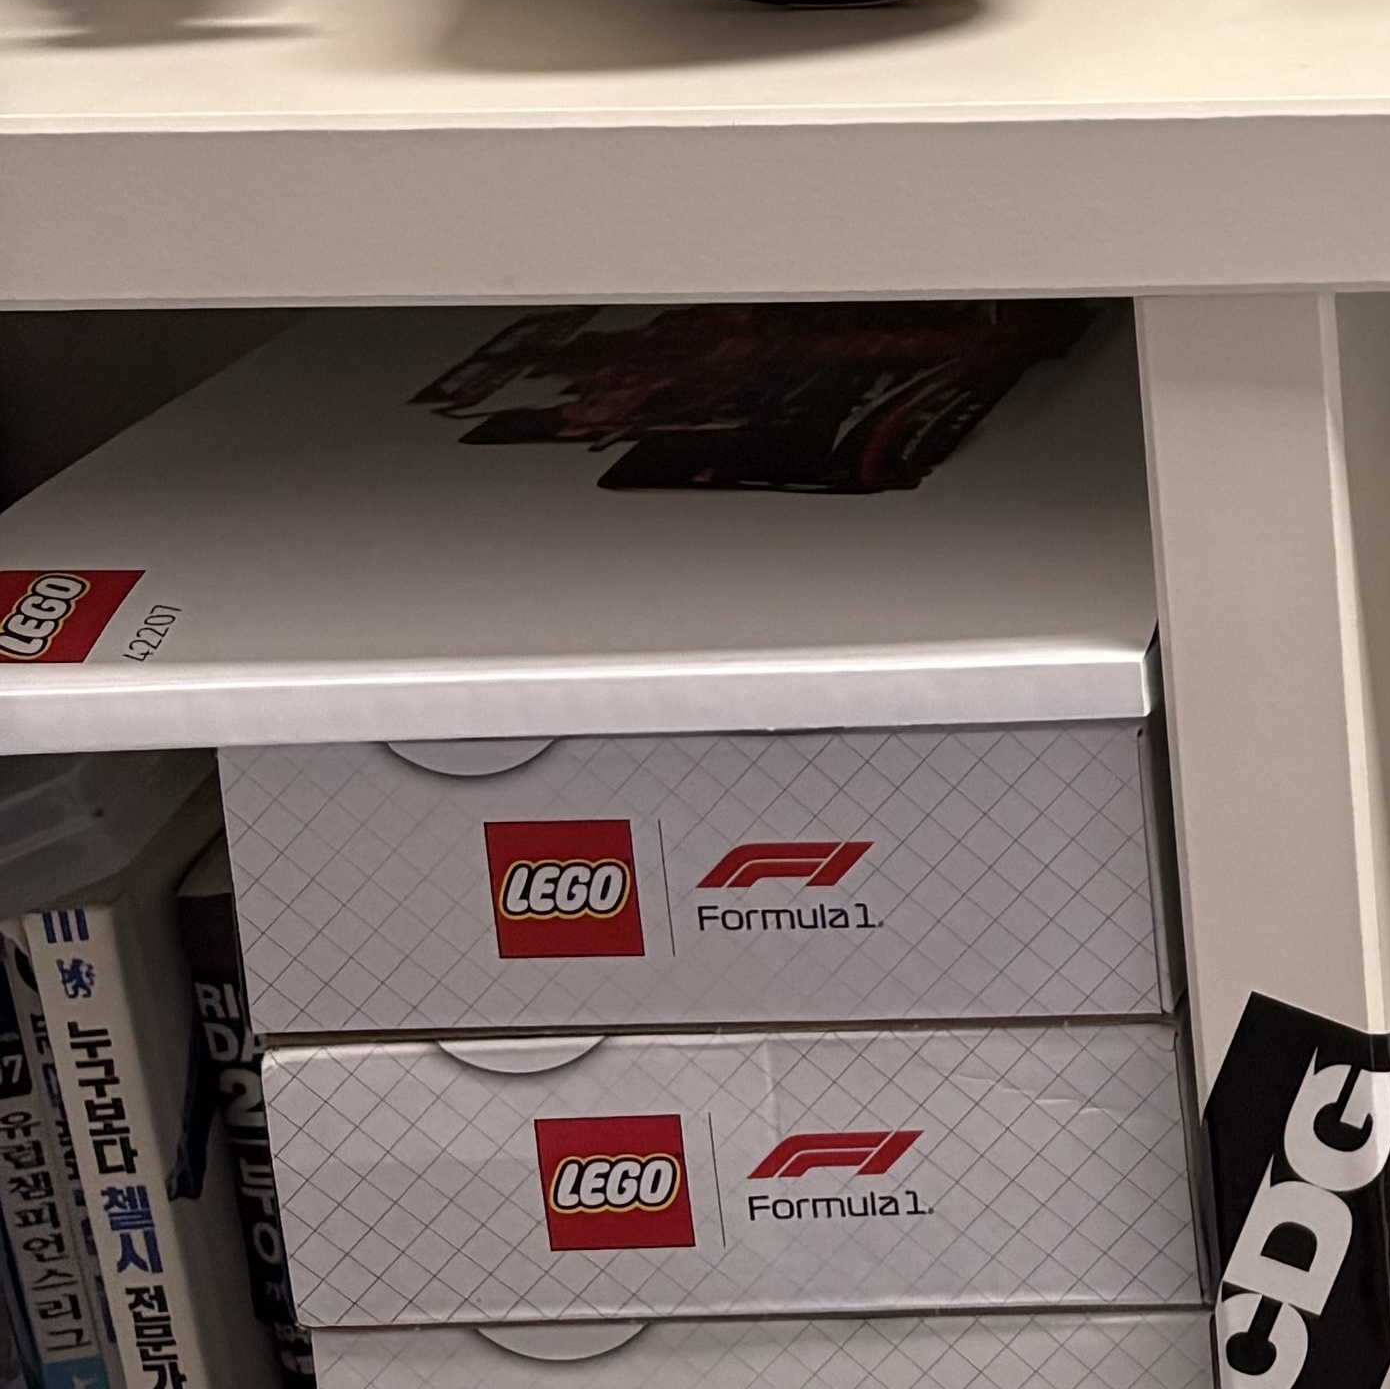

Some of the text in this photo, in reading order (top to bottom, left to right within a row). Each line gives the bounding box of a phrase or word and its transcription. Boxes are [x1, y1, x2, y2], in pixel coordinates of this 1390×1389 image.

[0, 571, 88, 659] LEGO
[123, 604, 182, 663] 42207
[502, 862, 627, 917] LEGO
[66, 1021, 139, 1178] 누구보다
[551, 1157, 678, 1210] LEGO
[101, 1184, 166, 1277] 첼시
